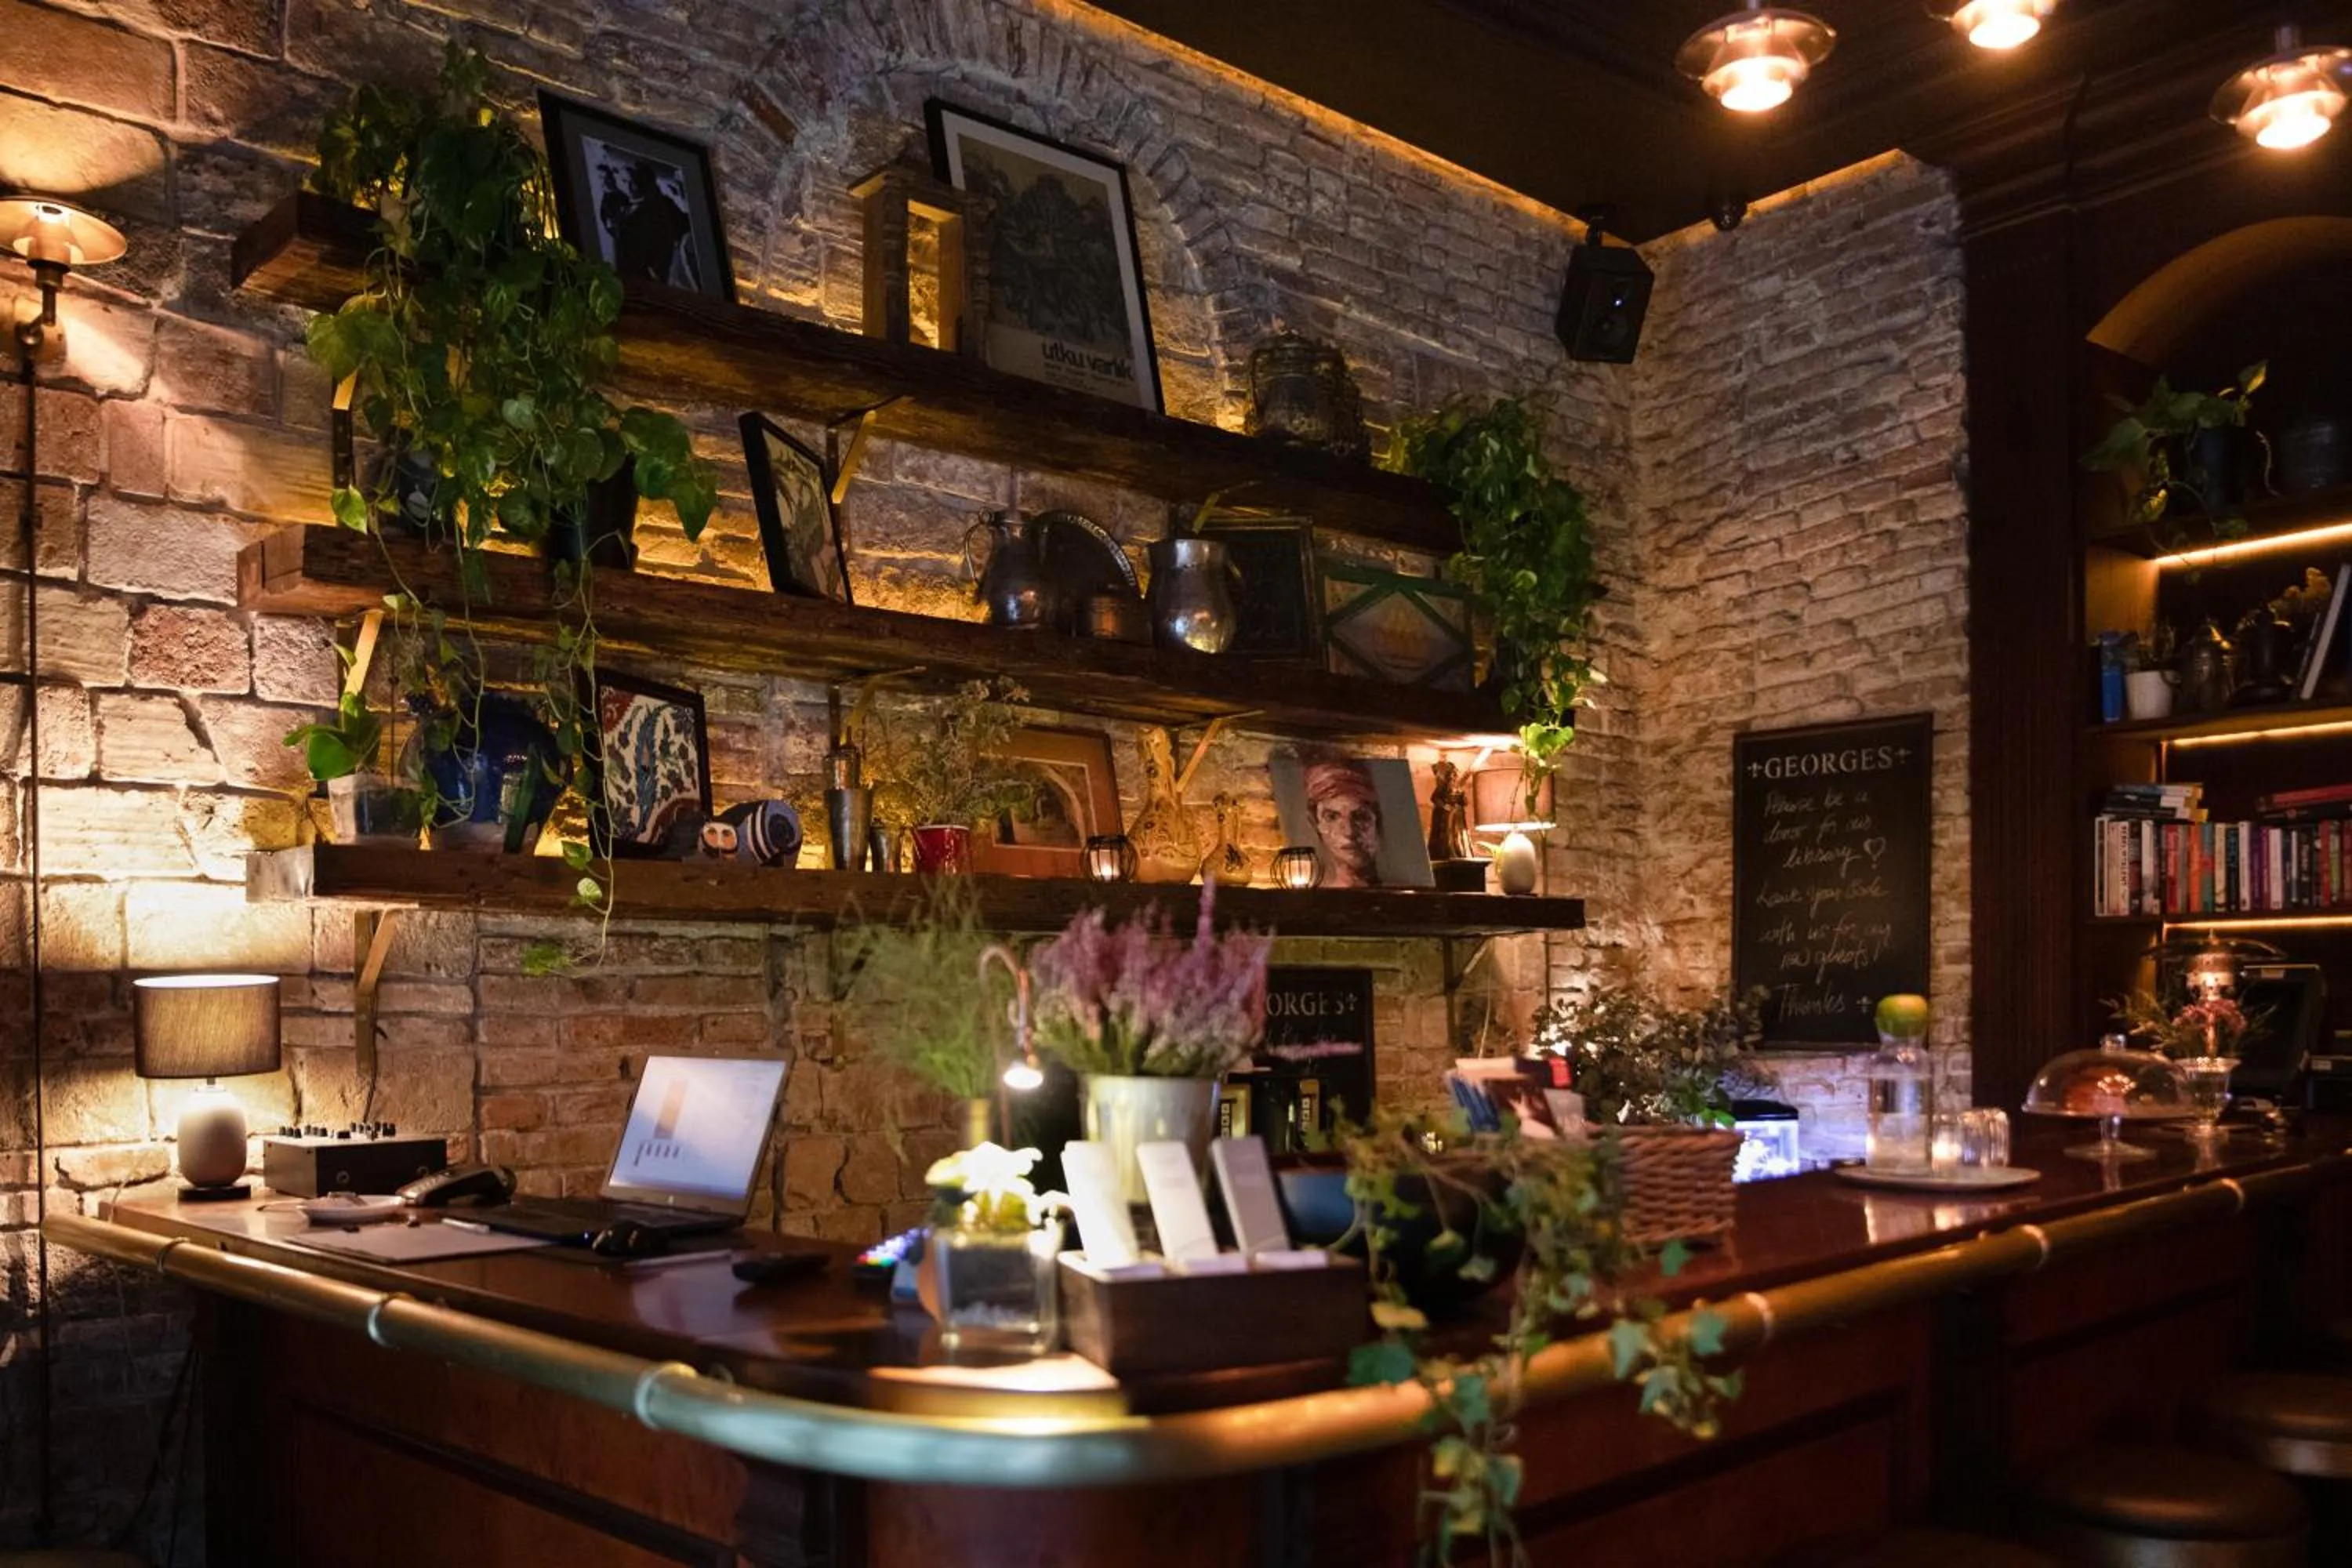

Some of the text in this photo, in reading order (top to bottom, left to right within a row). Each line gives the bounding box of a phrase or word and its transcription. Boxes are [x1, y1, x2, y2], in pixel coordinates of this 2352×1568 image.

[1764, 746, 1894, 779] GEORGES
[1824, 787, 1846, 808] be
[1266, 990, 1345, 1017] ORGES
